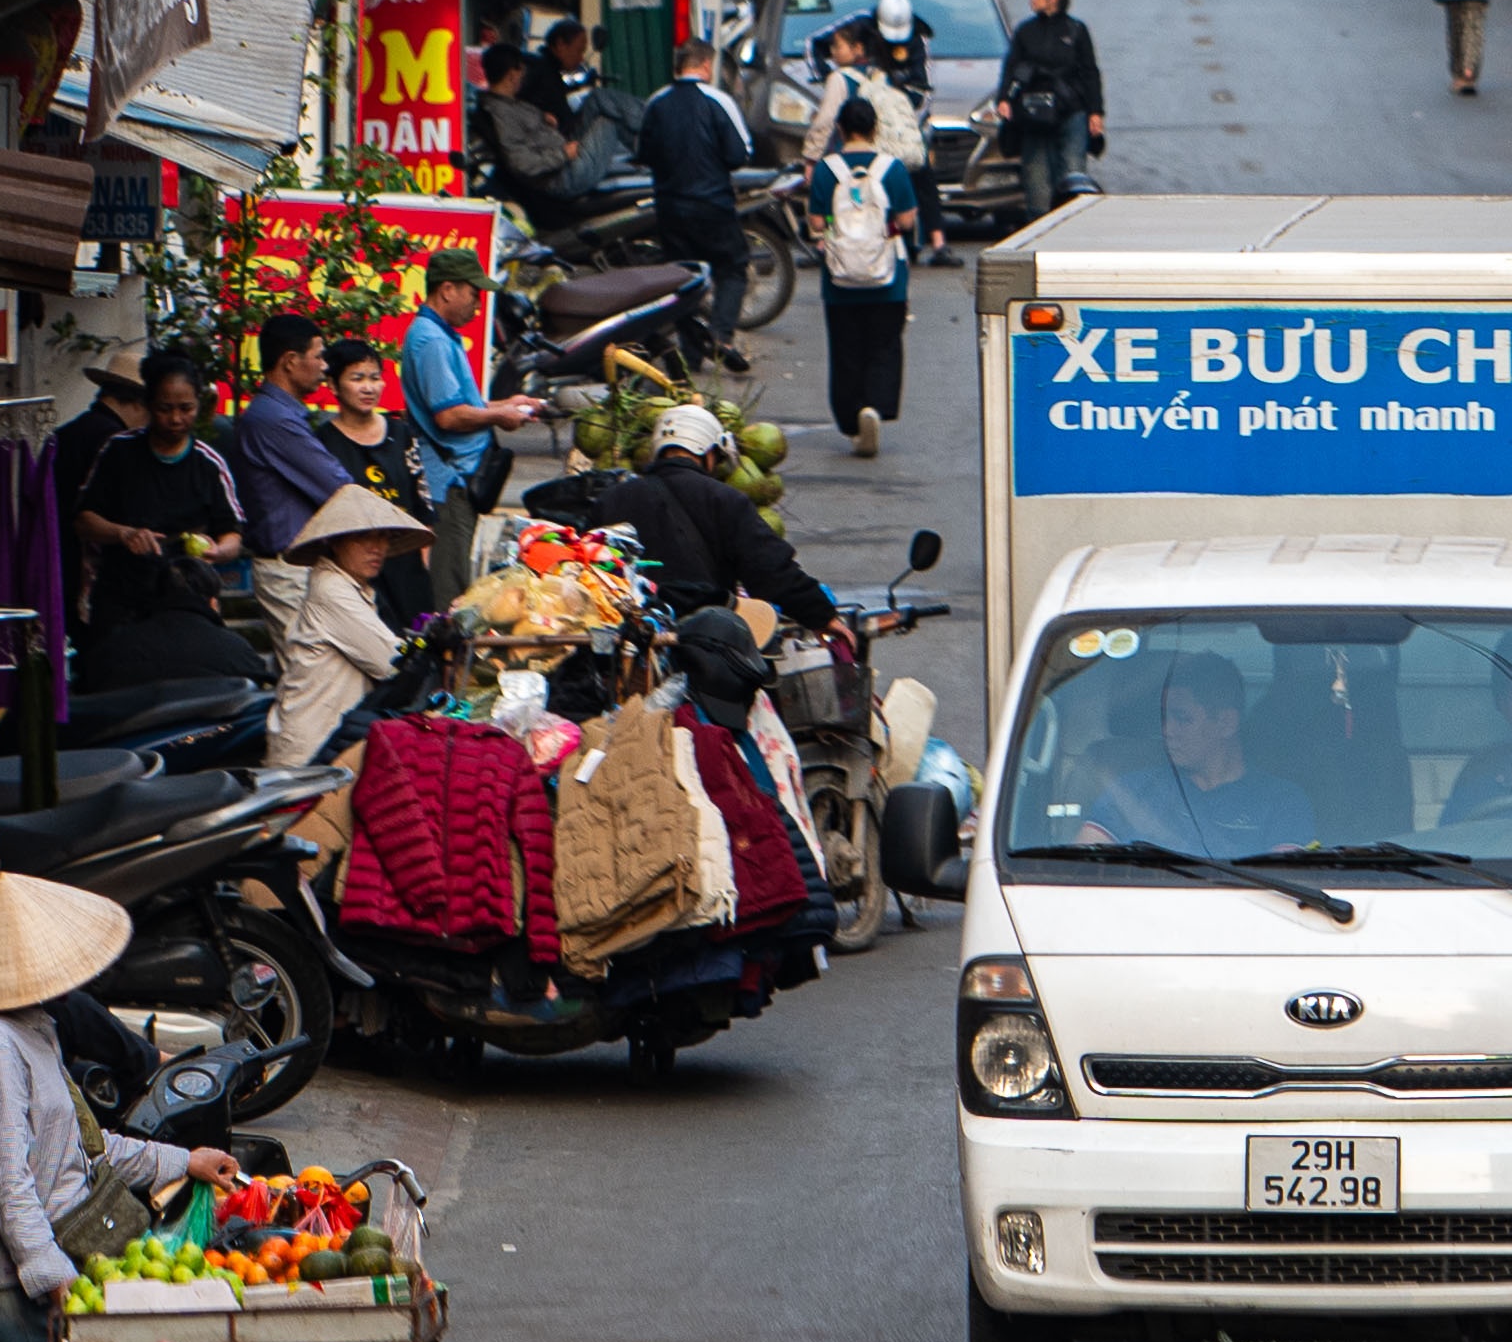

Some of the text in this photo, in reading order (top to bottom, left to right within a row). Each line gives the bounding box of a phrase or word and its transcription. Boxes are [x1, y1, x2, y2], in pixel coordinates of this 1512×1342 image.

[363, 110, 452, 154] DÂN
[1051, 326, 1160, 385] XE
[1190, 316, 1369, 387] BƯU
[1048, 390, 1220, 441] Chuyển
[1239, 395, 1340, 437] phát
[1360, 400, 1496, 433] nhanh
[1295, 995, 1352, 1021] KIA
[1290, 1140, 1356, 1173] 29H
[1262, 1175, 1382, 1208] 542.98
